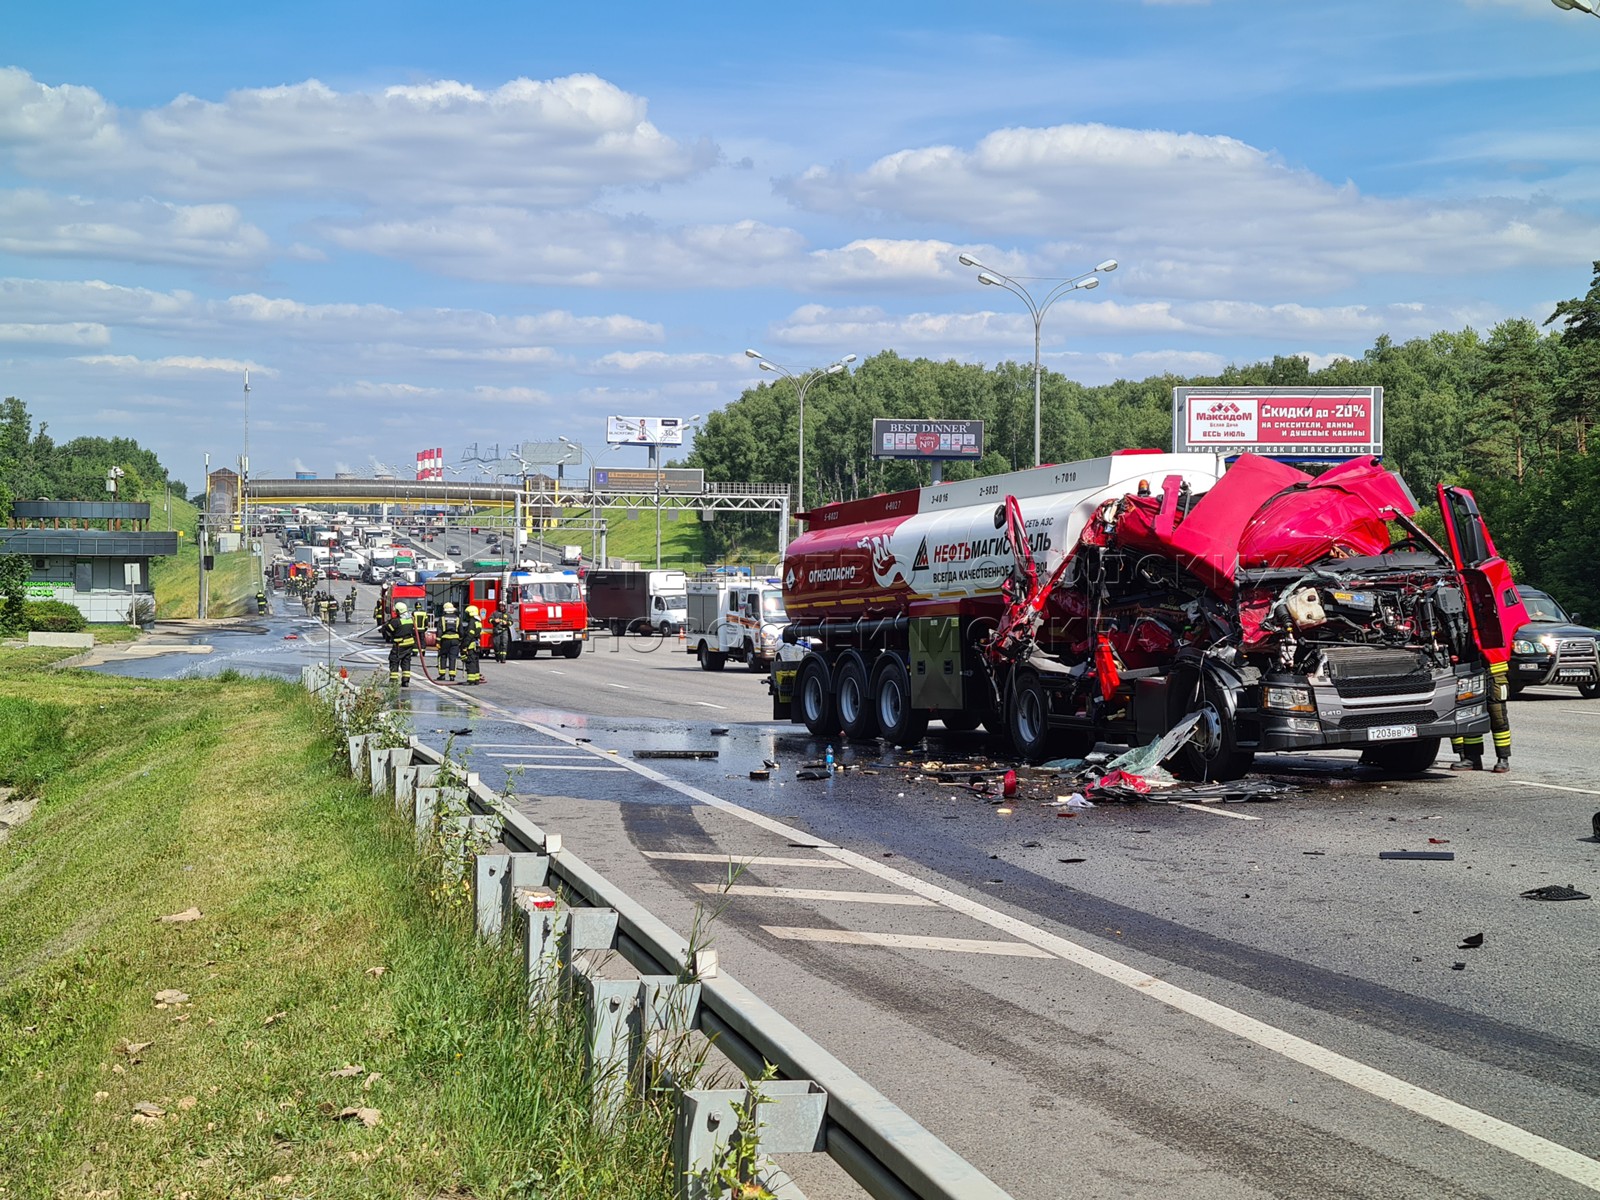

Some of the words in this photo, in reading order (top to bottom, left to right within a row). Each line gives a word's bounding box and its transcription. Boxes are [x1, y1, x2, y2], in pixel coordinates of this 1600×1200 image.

[1331, 404, 1366, 418] -20%
[890, 423, 920, 432] BEST
[922, 424, 967, 433] DINNER
[1274, 422, 1323, 430] СМЕСИТЕЛИ,
[1055, 472, 1077, 484] 1-7010
[979, 485, 999, 497] 2-5033
[1025, 519, 1039, 529] СЕТЬ
[1040, 517, 1054, 526] АЗС
[808, 566, 856, 583] ОГНЕОПАСНО
[933, 571, 958, 584] ВСЕГДА
[959, 565, 1009, 581] КАЧЕСТВЕННОЕ
